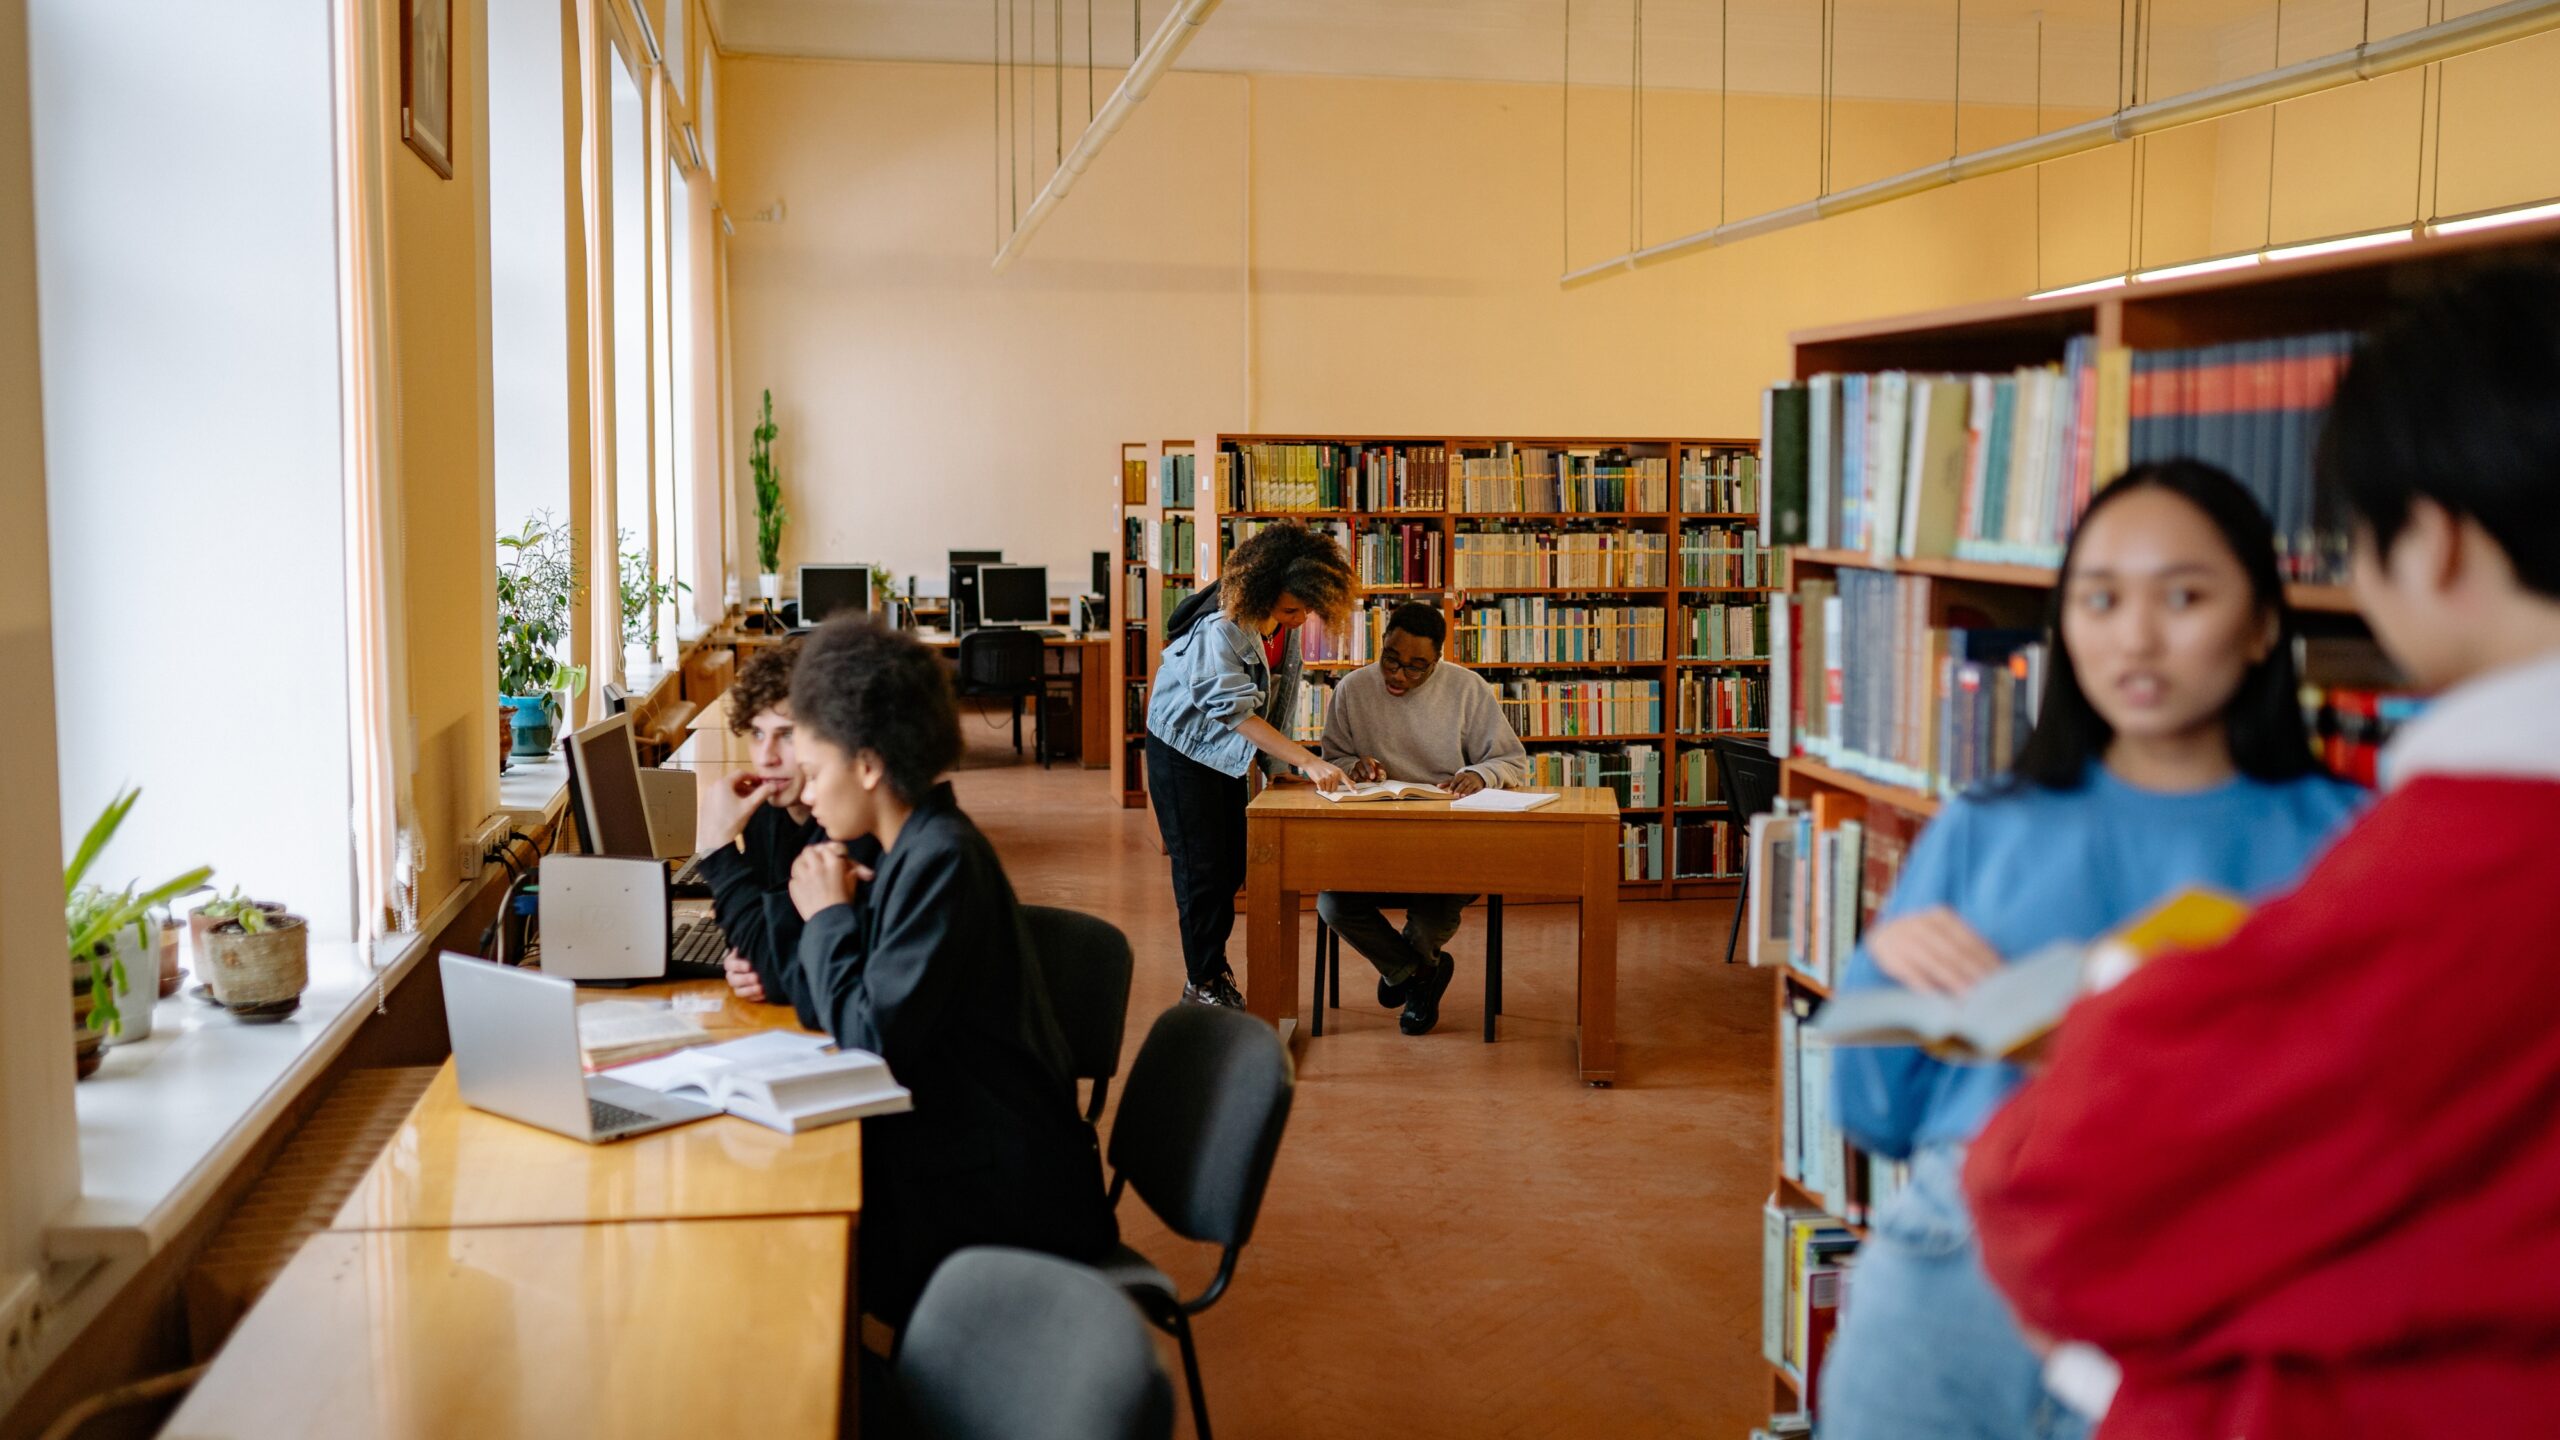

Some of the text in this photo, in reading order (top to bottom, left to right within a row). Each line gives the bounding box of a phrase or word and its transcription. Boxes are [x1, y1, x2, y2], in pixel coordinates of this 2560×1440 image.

[1713, 607, 1721, 616] Б
[1588, 756, 1597, 765] Б
[1649, 753, 1656, 762] В
[1690, 754, 1699, 763] И
[1652, 826, 1659, 835] Т
